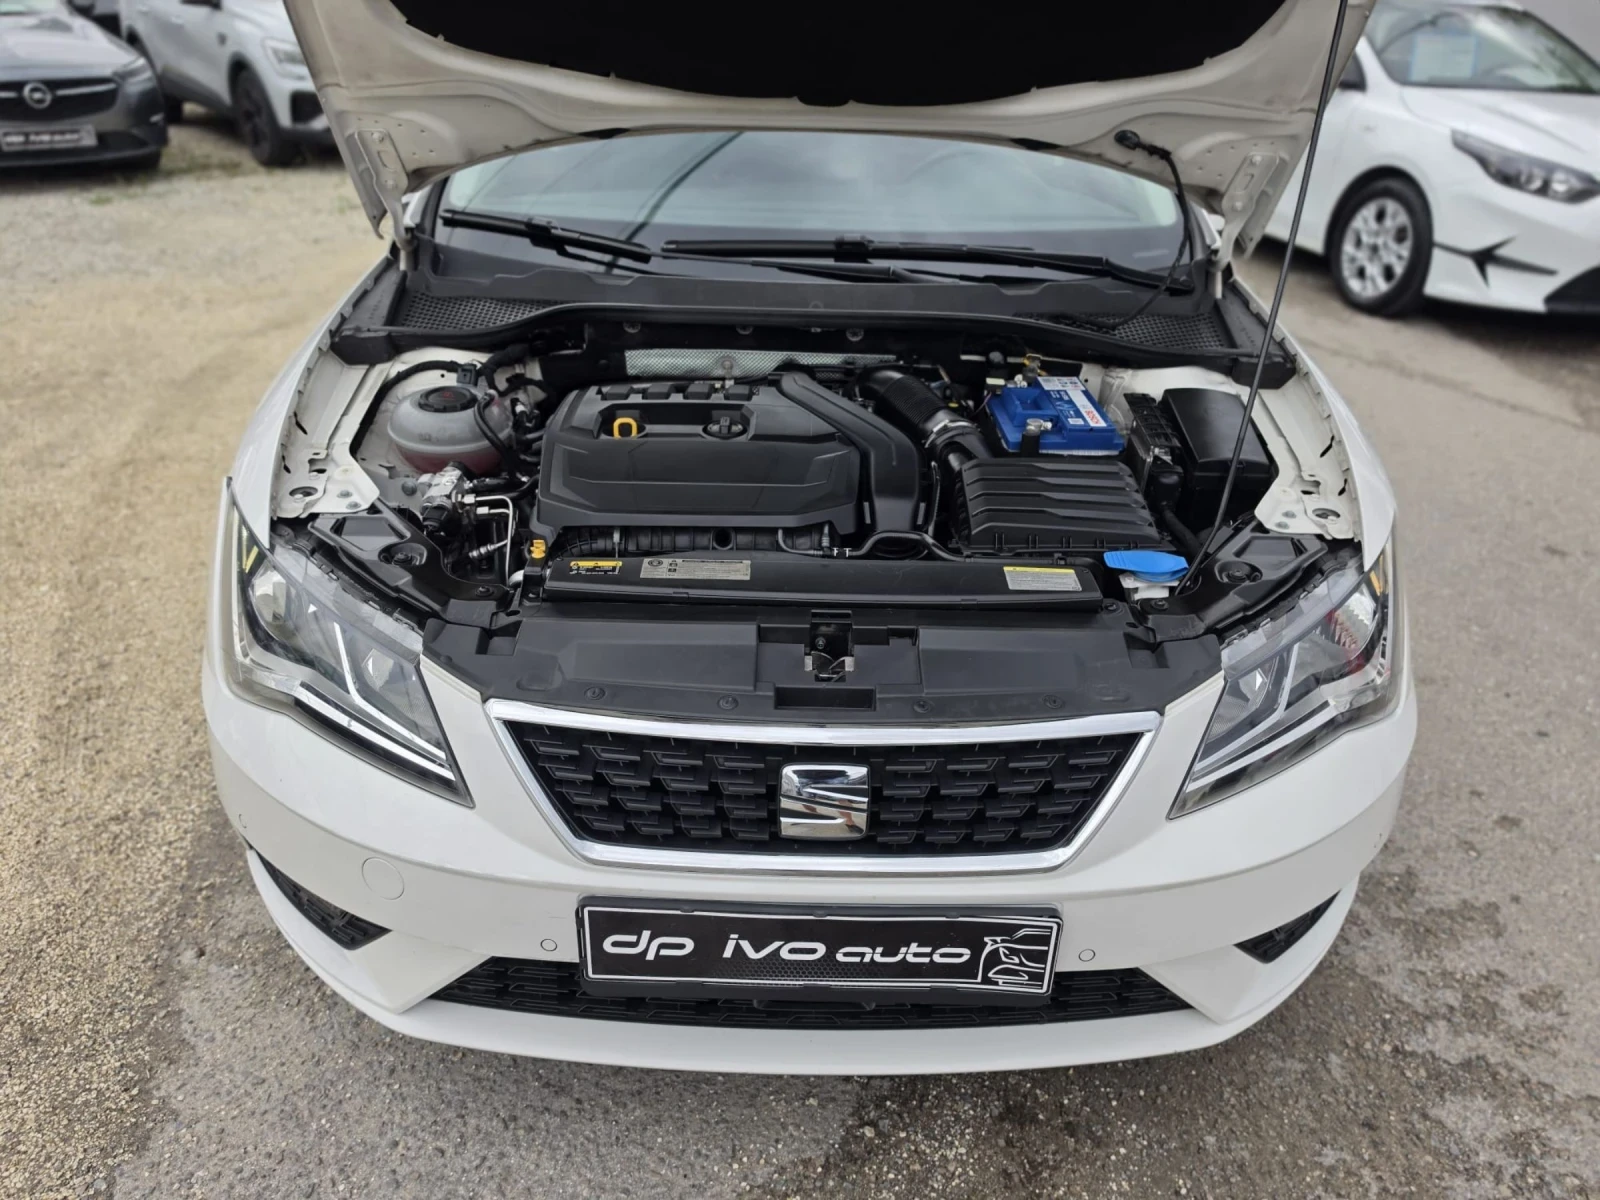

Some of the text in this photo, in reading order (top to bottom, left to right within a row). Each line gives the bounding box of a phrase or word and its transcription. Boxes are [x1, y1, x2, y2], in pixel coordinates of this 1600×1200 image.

[602, 929, 972, 964] dp ivo auto
